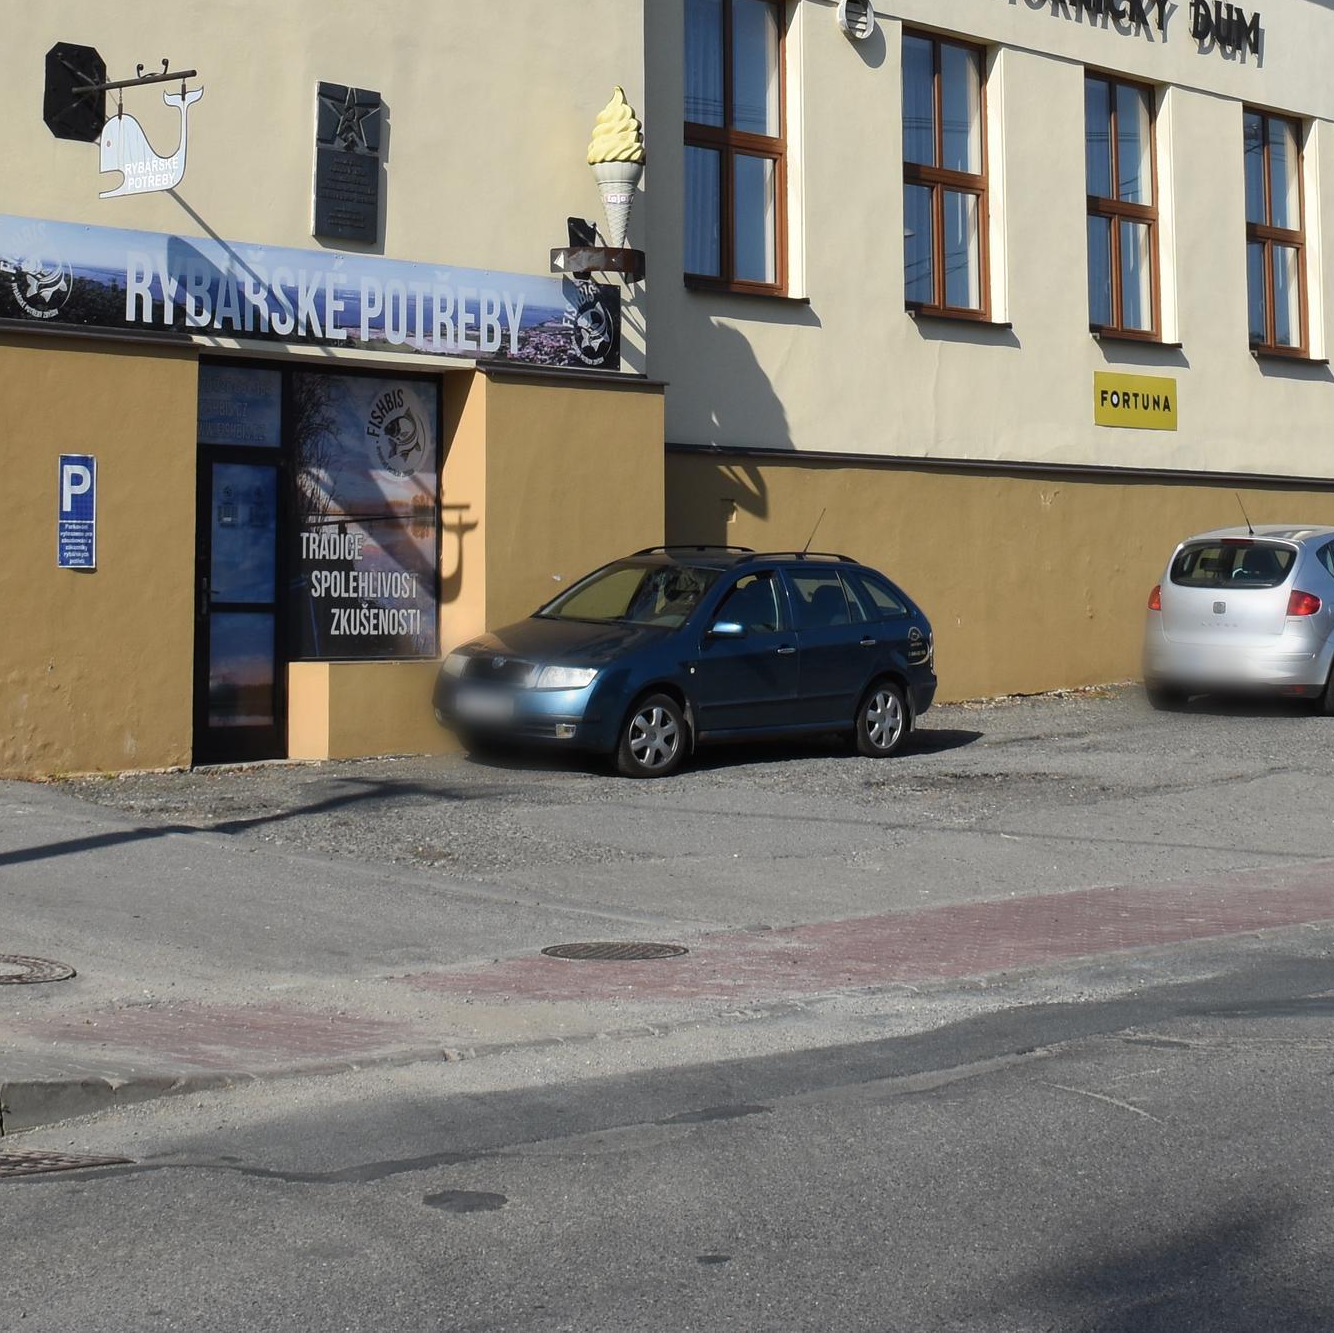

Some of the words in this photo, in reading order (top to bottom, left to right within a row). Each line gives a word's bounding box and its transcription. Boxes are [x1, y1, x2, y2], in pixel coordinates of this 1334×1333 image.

[125, 250, 348, 340] RYBÁŘSKÉ
[360, 270, 526, 355] POTŘEBY
[367, 388, 404, 438] FISHBIS
[1100, 390, 1171, 412] FORTUNA
[63, 464, 92, 512] P
[300, 532, 364, 560] TRADICE
[311, 570, 419, 598] SPOLEHLIVOST
[330, 603, 421, 636] ZKUŠENOSTI
